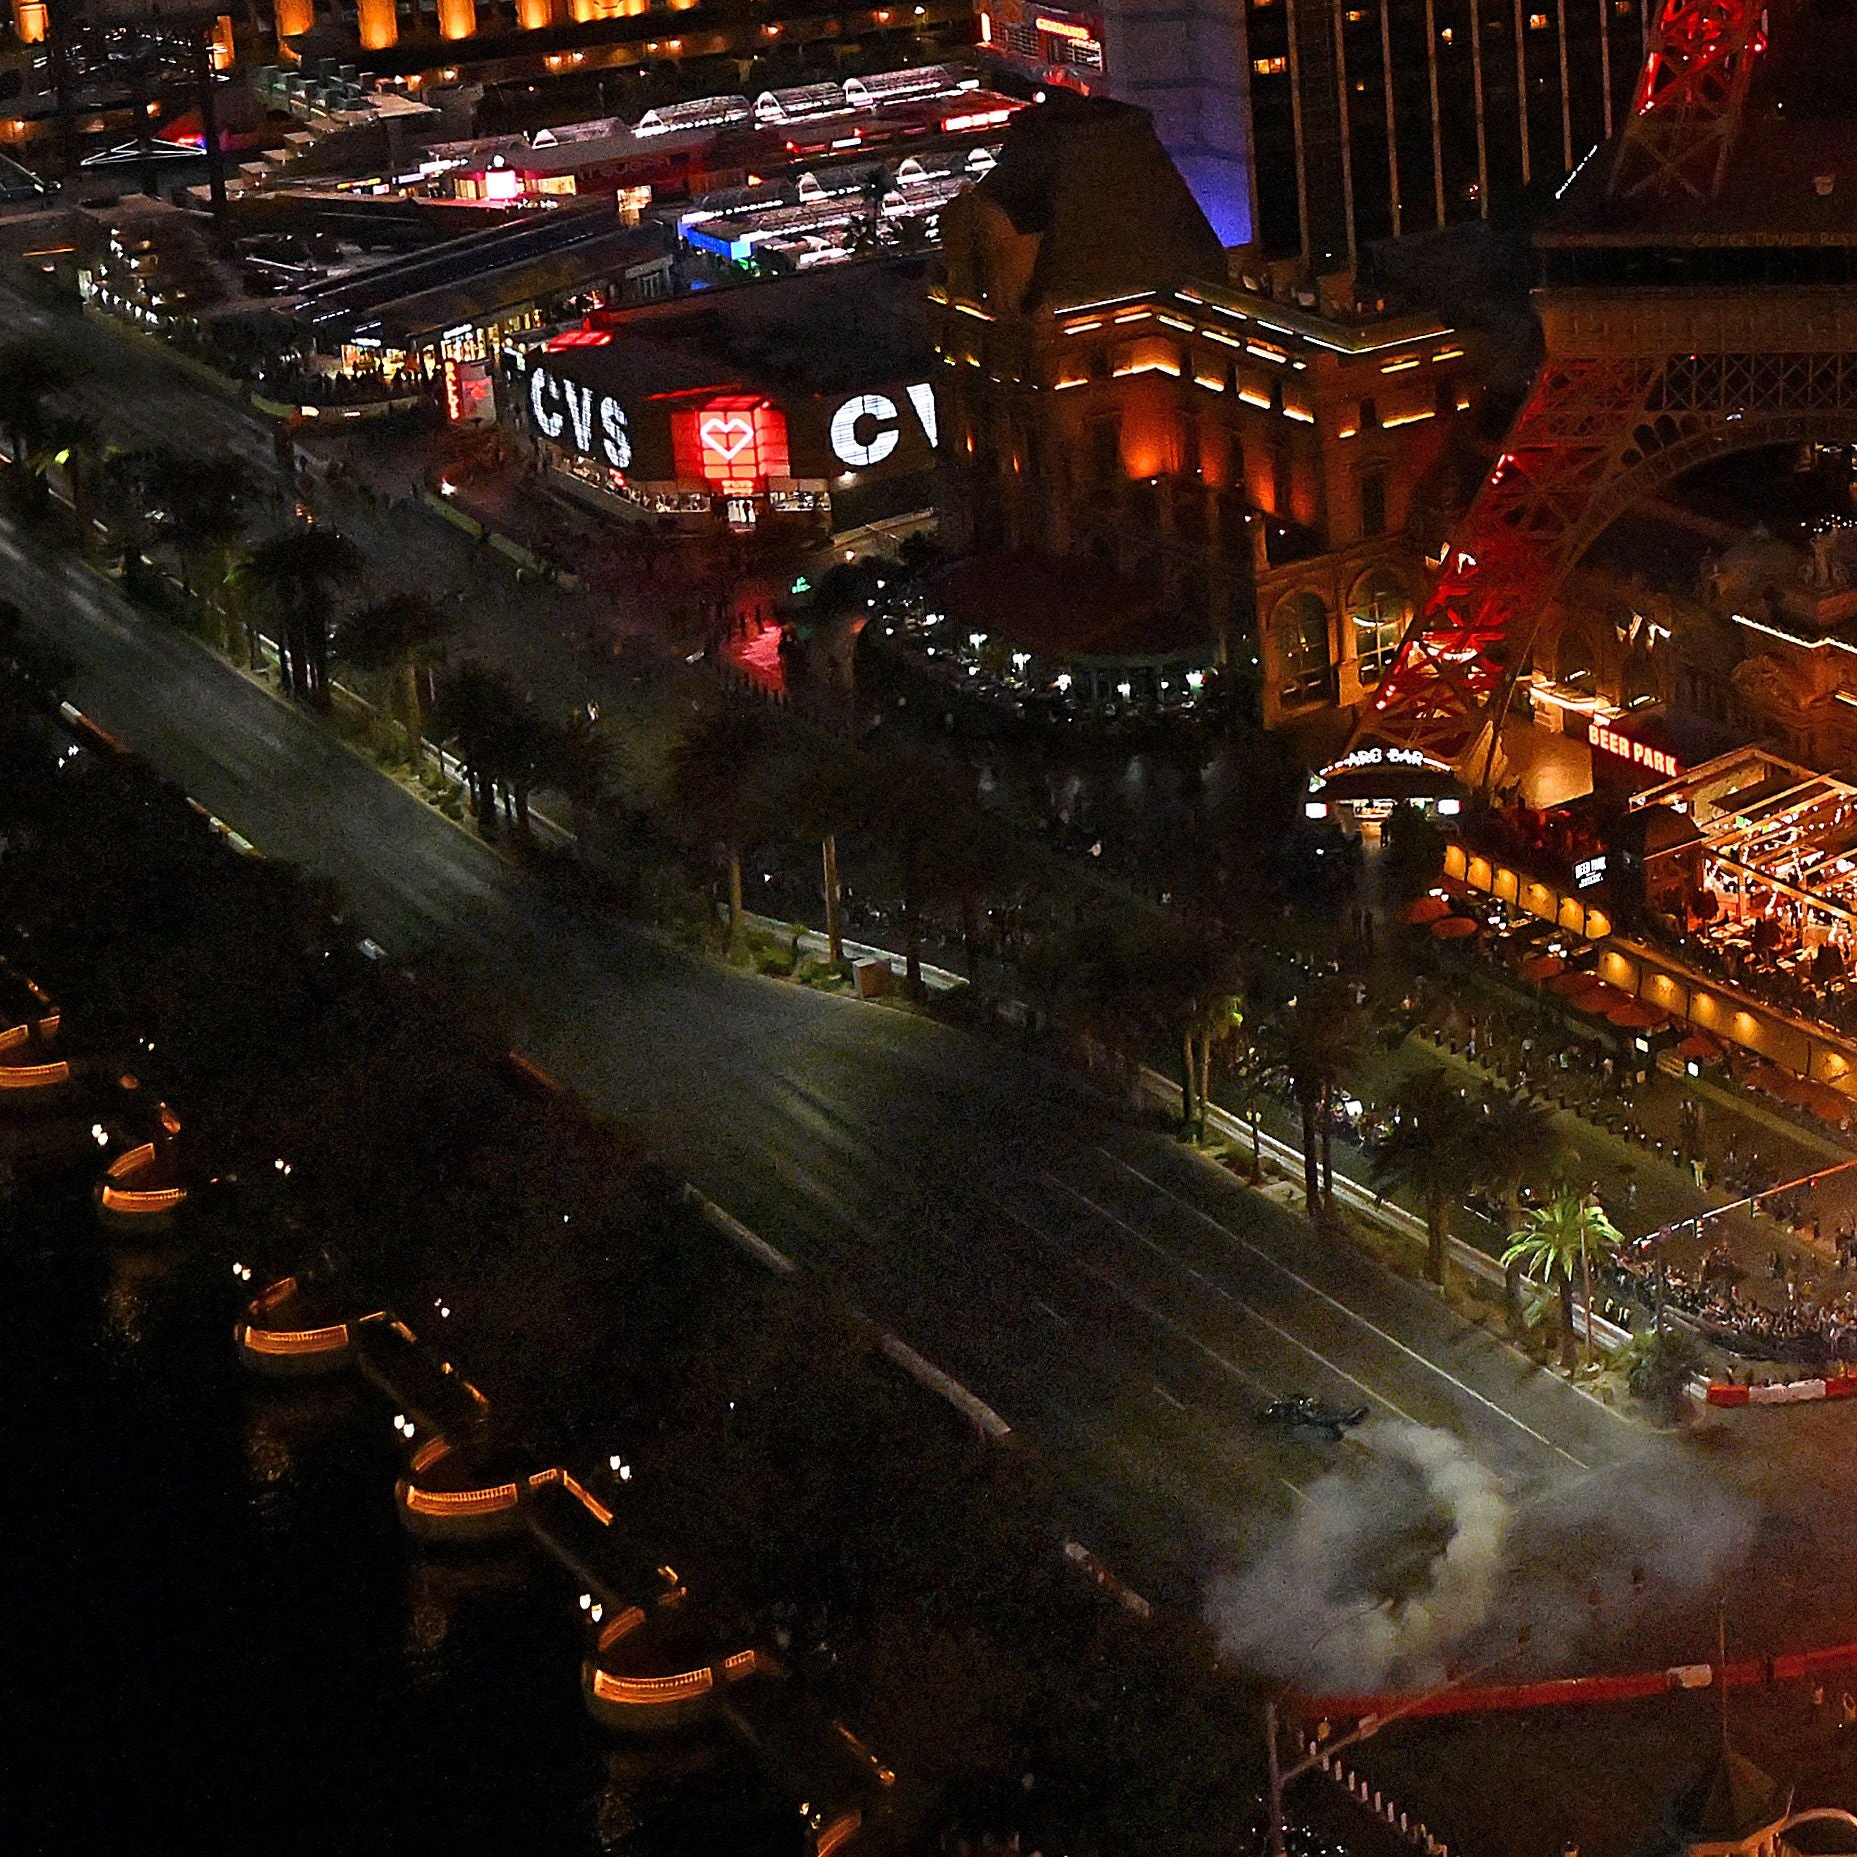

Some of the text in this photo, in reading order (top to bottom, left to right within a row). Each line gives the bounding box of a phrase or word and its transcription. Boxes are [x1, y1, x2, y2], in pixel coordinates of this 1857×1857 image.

[531, 368, 632, 468] CVS
[1387, 748, 1424, 767] BAR
[1588, 724, 1677, 778] BEER PARK
